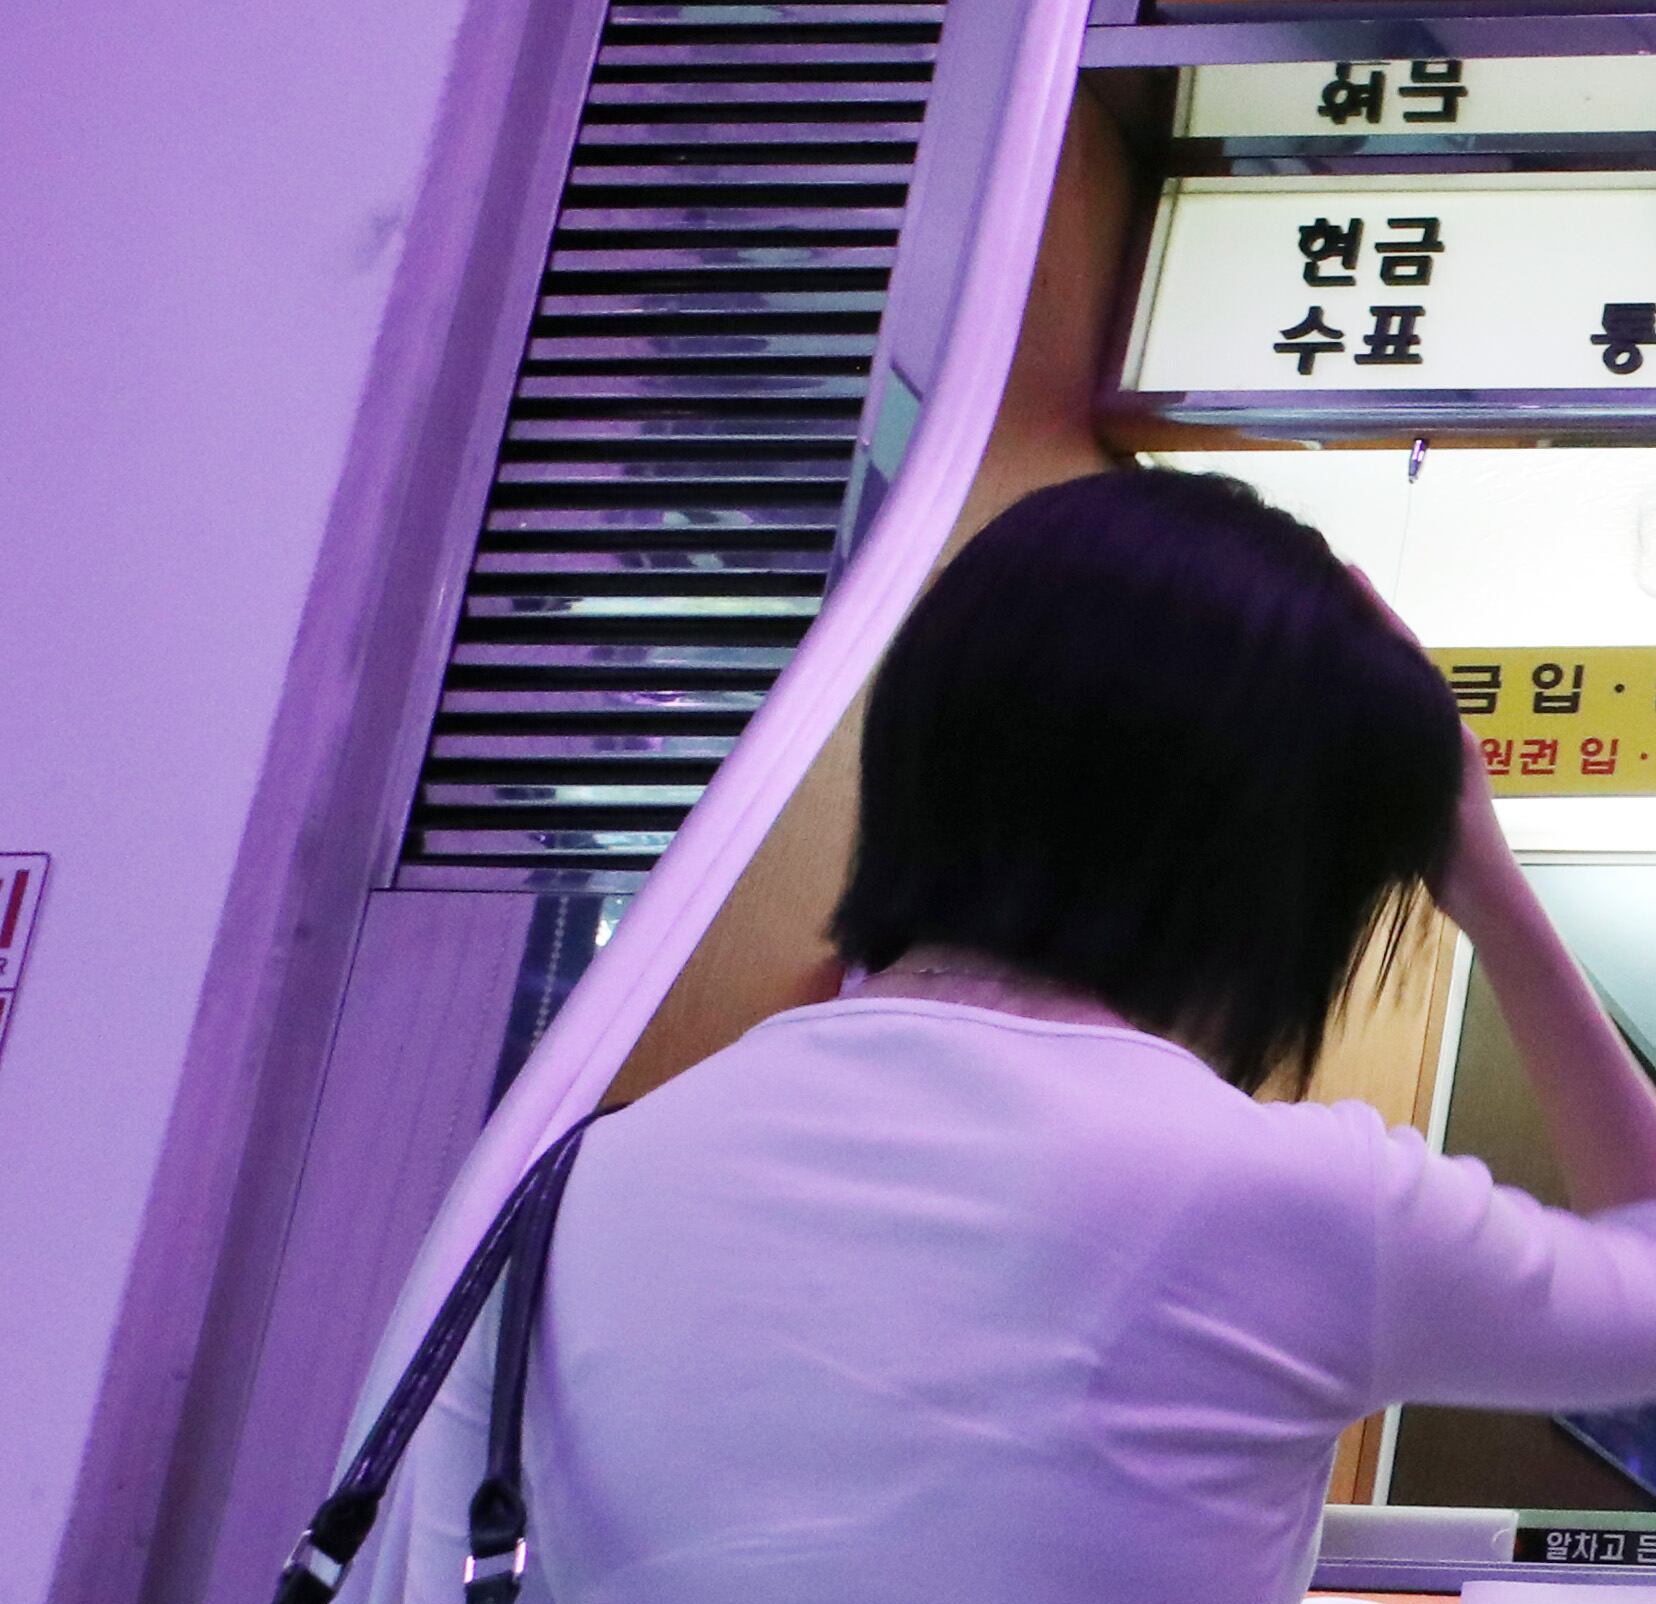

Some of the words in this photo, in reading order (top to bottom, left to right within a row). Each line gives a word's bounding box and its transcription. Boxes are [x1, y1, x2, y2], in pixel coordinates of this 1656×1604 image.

[1297, 216, 1447, 287] 현금
[1273, 306, 1426, 377] 수표
[1451, 664, 1502, 714] 금
[1546, 1531, 1625, 1561] 알차고
